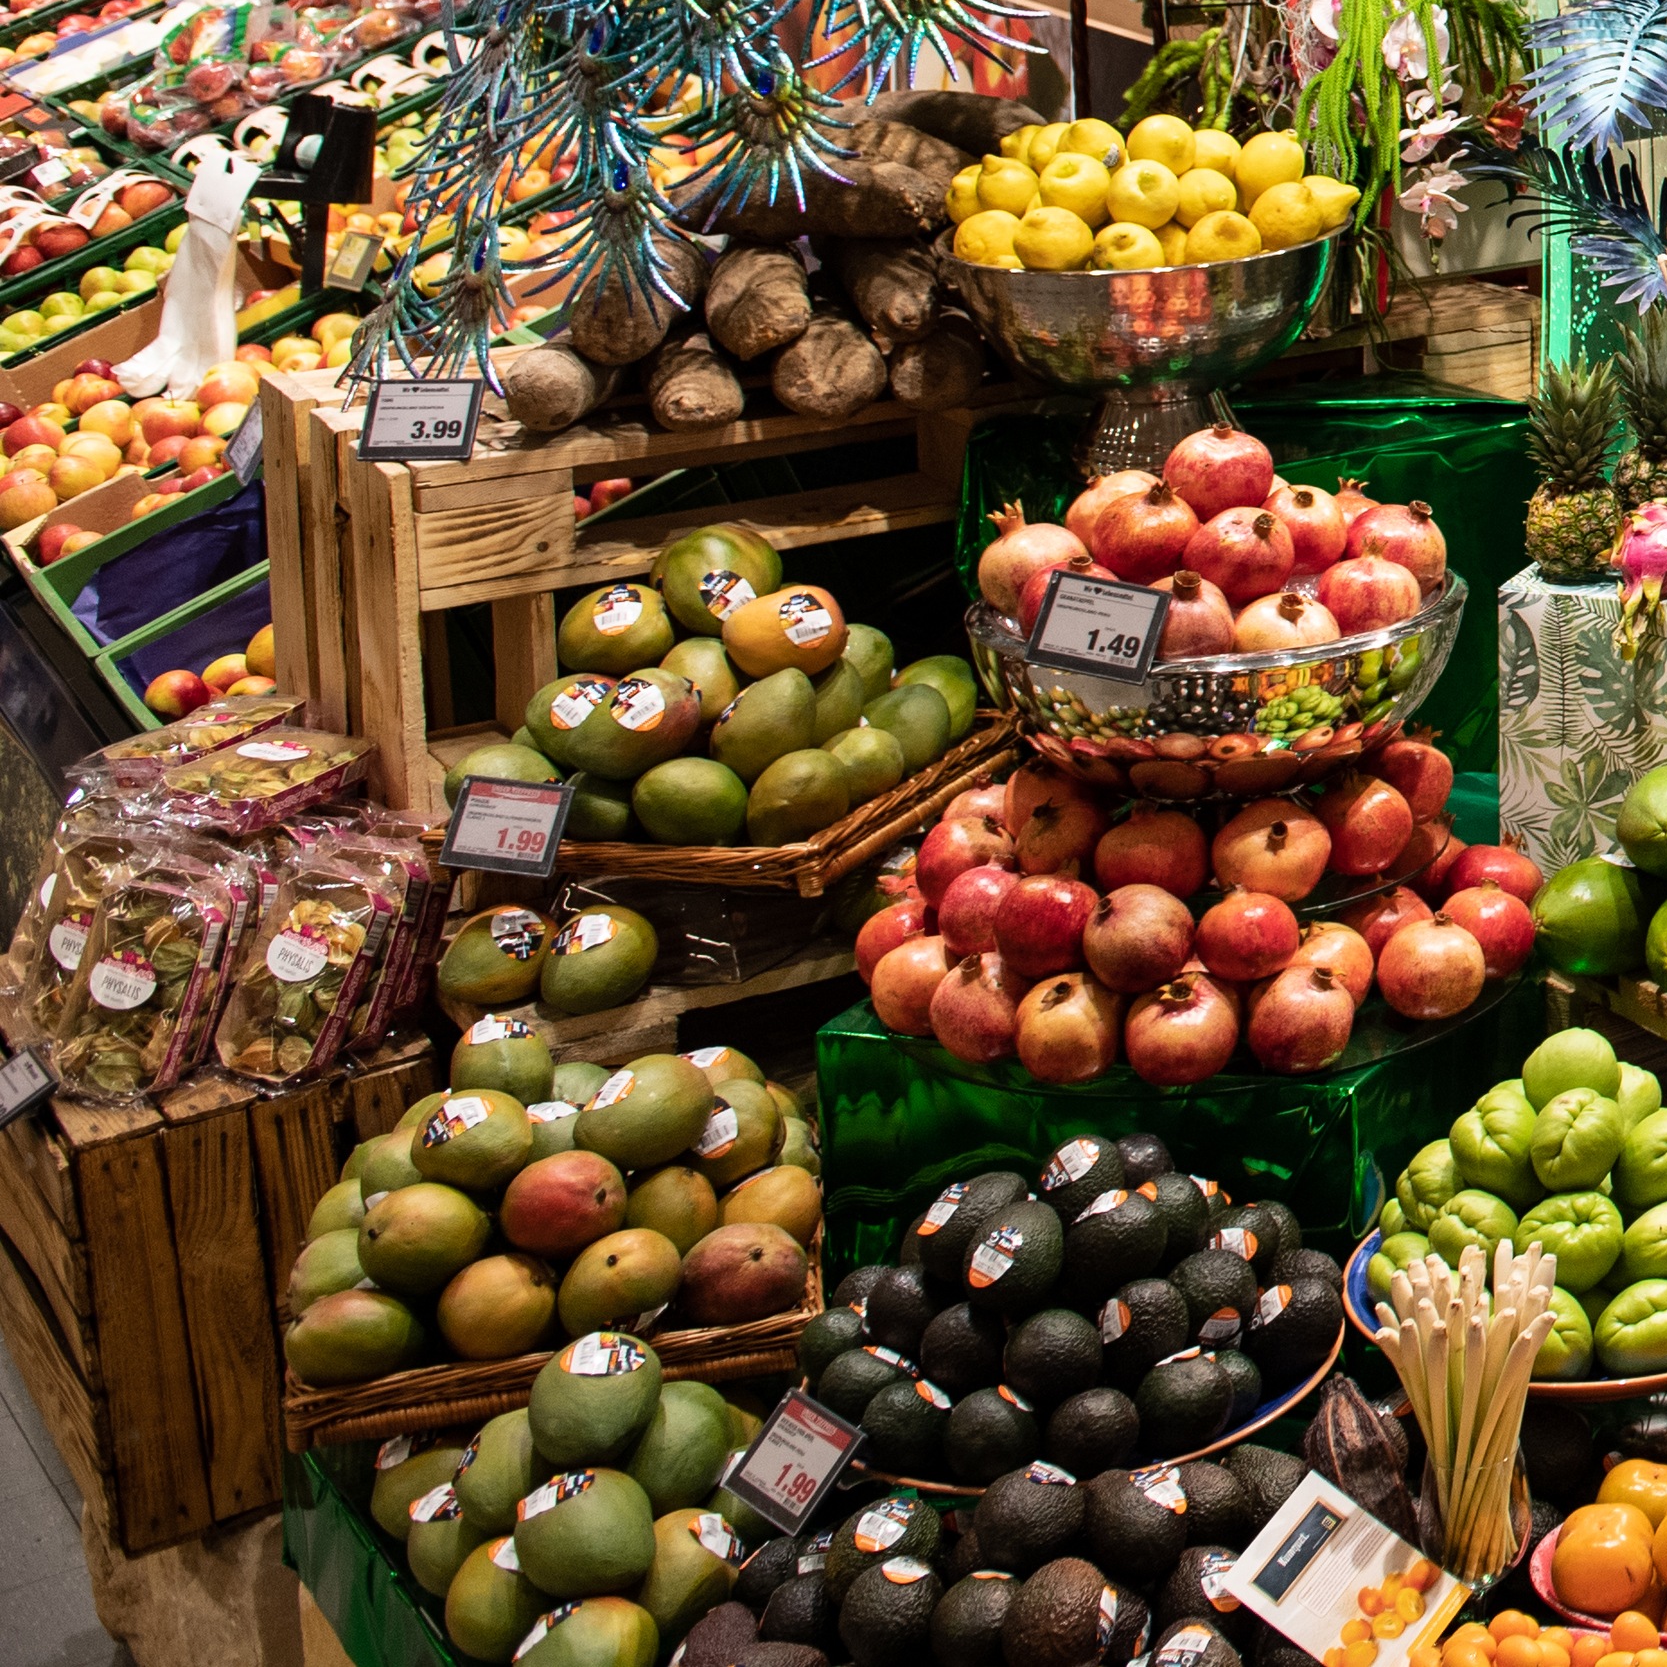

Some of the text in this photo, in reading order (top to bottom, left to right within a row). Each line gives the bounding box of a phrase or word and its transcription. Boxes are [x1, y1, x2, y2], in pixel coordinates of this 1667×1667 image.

[410, 420, 463, 439] 3.99
[1087, 629, 1141, 659] 1.49
[497, 827, 547, 853] 1.99
[277, 947, 314, 973] PHYSALIS
[101, 975, 141, 1000] PHYSALIS
[775, 1463, 817, 1504] 1.99
